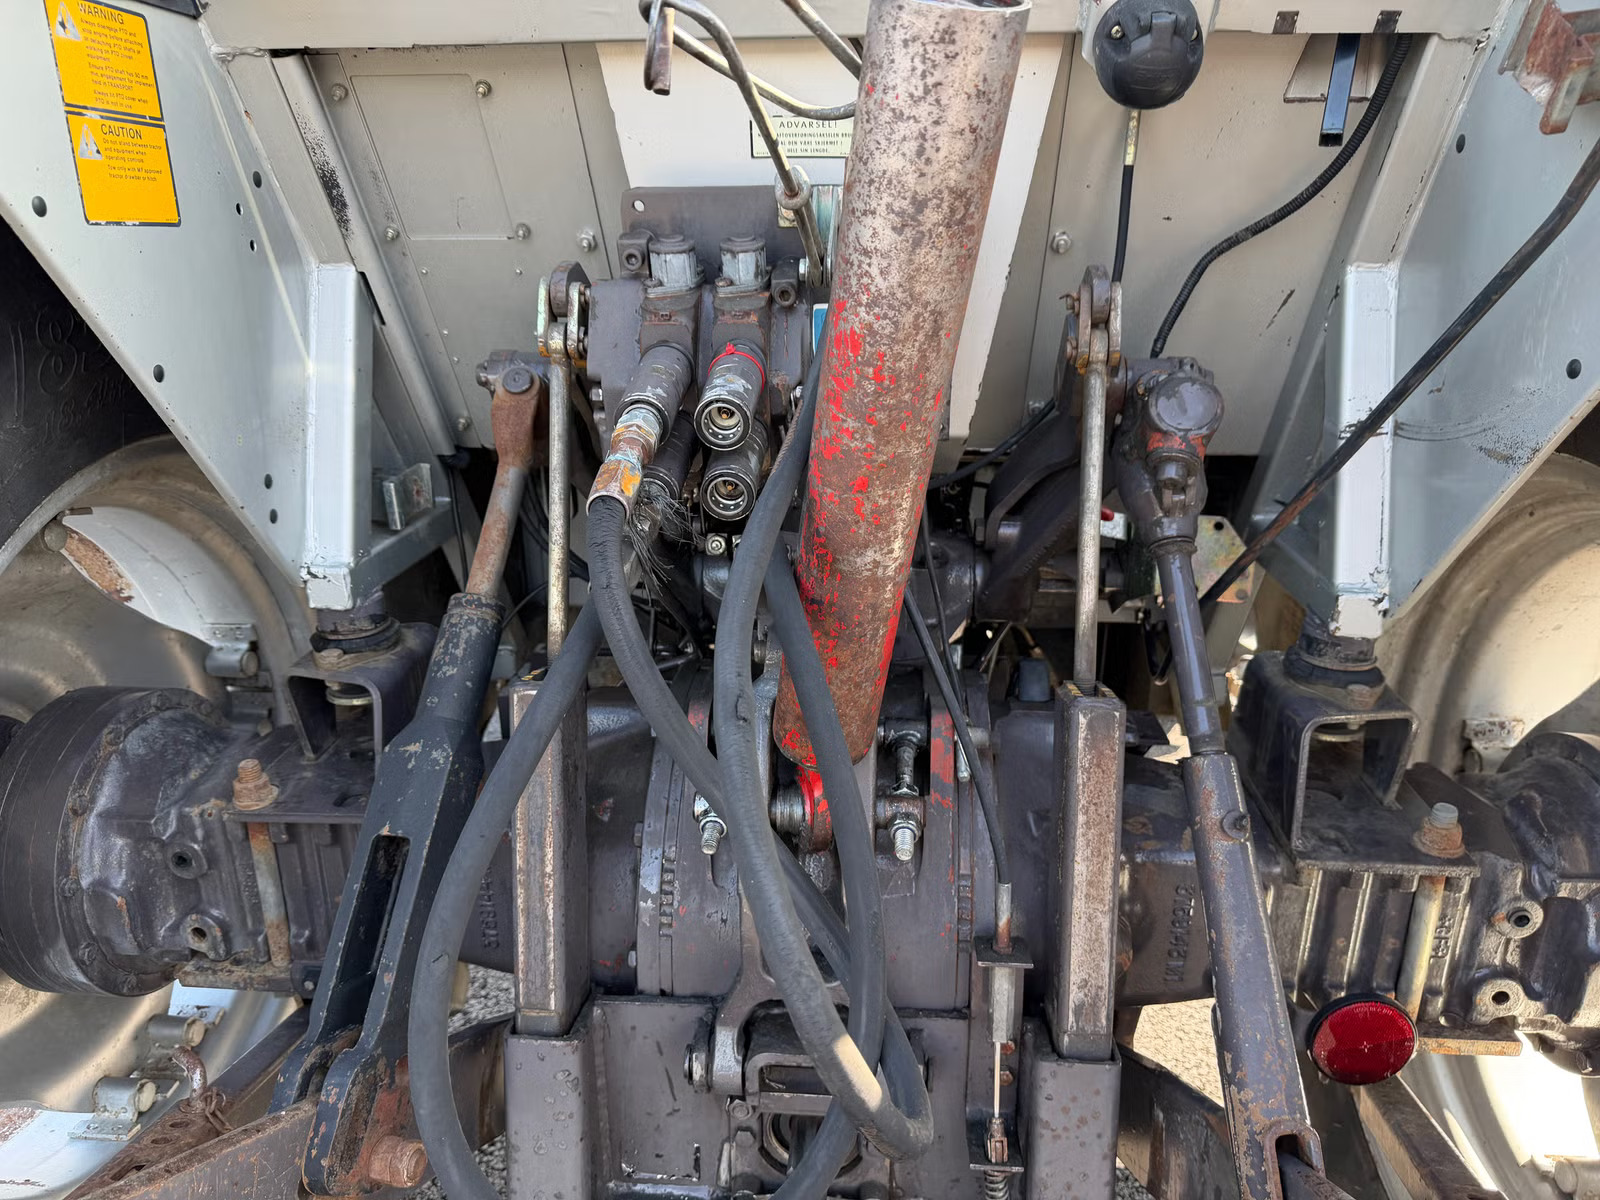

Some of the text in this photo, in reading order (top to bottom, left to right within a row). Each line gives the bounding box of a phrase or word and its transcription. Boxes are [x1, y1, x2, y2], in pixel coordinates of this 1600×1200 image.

[77, 2, 124, 24] WARNING
[108, 82, 133, 90] TRANSPORT
[101, 124, 142, 140] CAUTION
